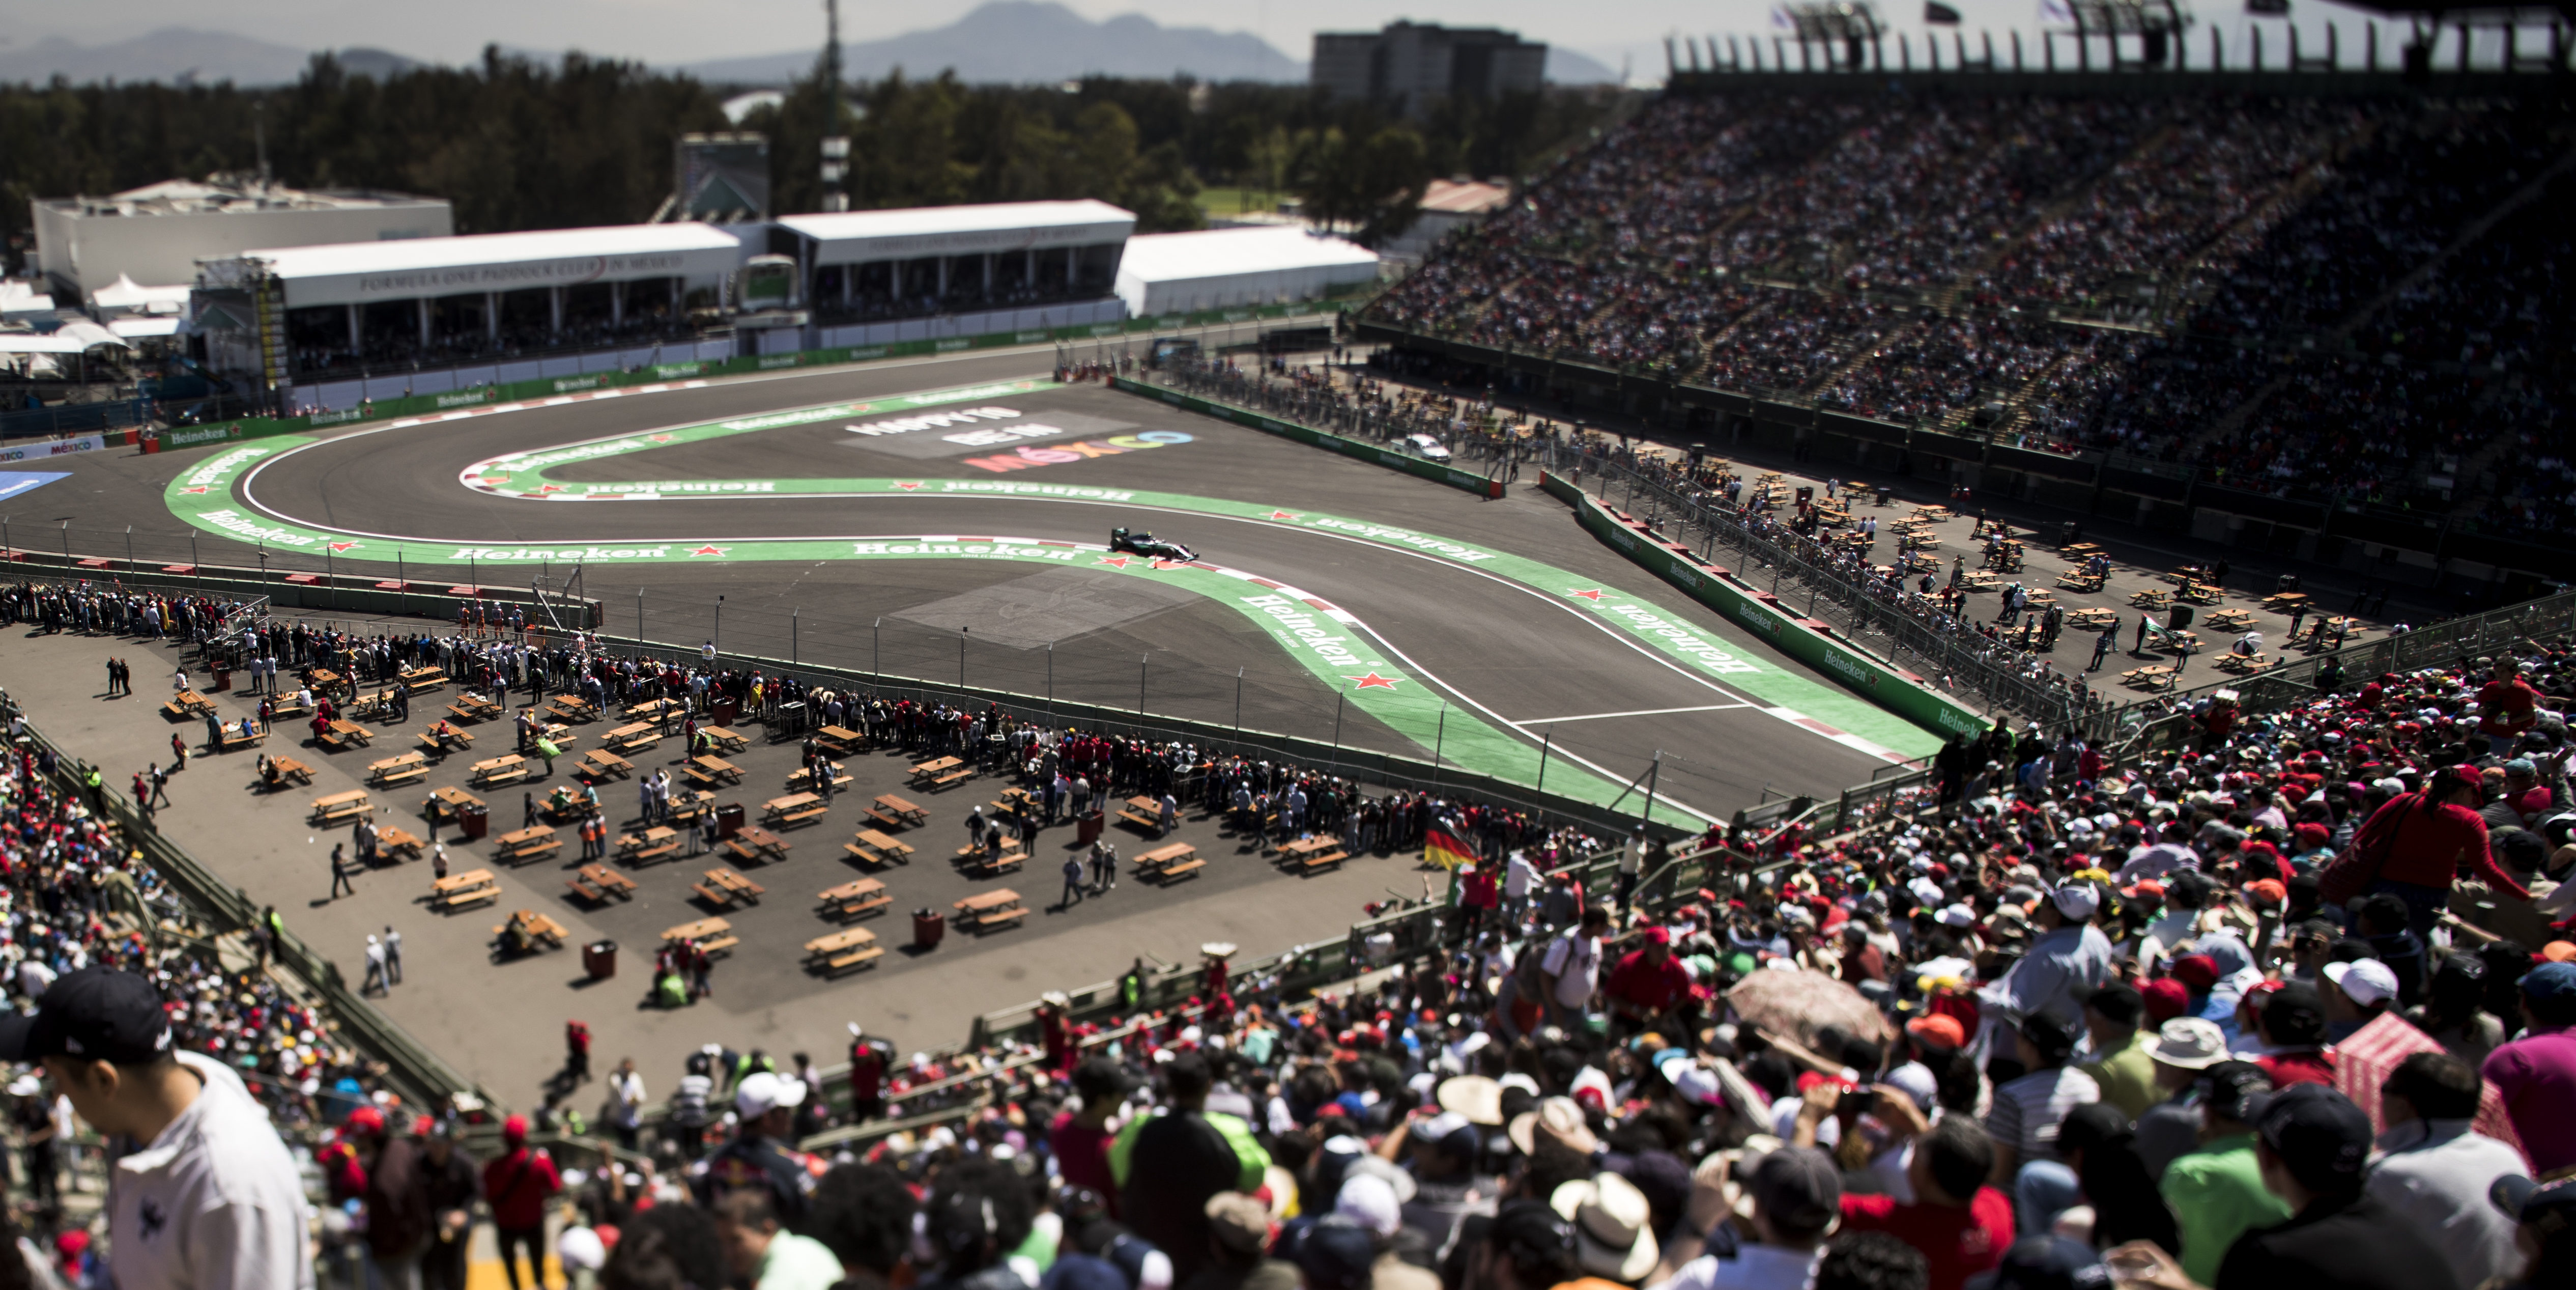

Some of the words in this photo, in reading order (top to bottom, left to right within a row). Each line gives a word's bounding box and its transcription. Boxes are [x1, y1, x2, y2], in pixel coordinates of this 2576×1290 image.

[171, 427, 226, 445] Heineken
[587, 482, 775, 493] Heineken
[944, 482, 1136, 501] Heineken
[196, 509, 316, 546] Heineken
[1316, 518, 1496, 561] Heineken
[1611, 527, 1634, 550] Heineken
[448, 547, 667, 559] Heineken
[853, 543, 1075, 560] Heineken
[1670, 562, 1696, 587] Heineken
[1739, 602, 1771, 631] Heineken
[1240, 594, 1362, 667] Heineken
[1610, 604, 1763, 674] Heineken
[1823, 649, 1867, 683] Heineken
